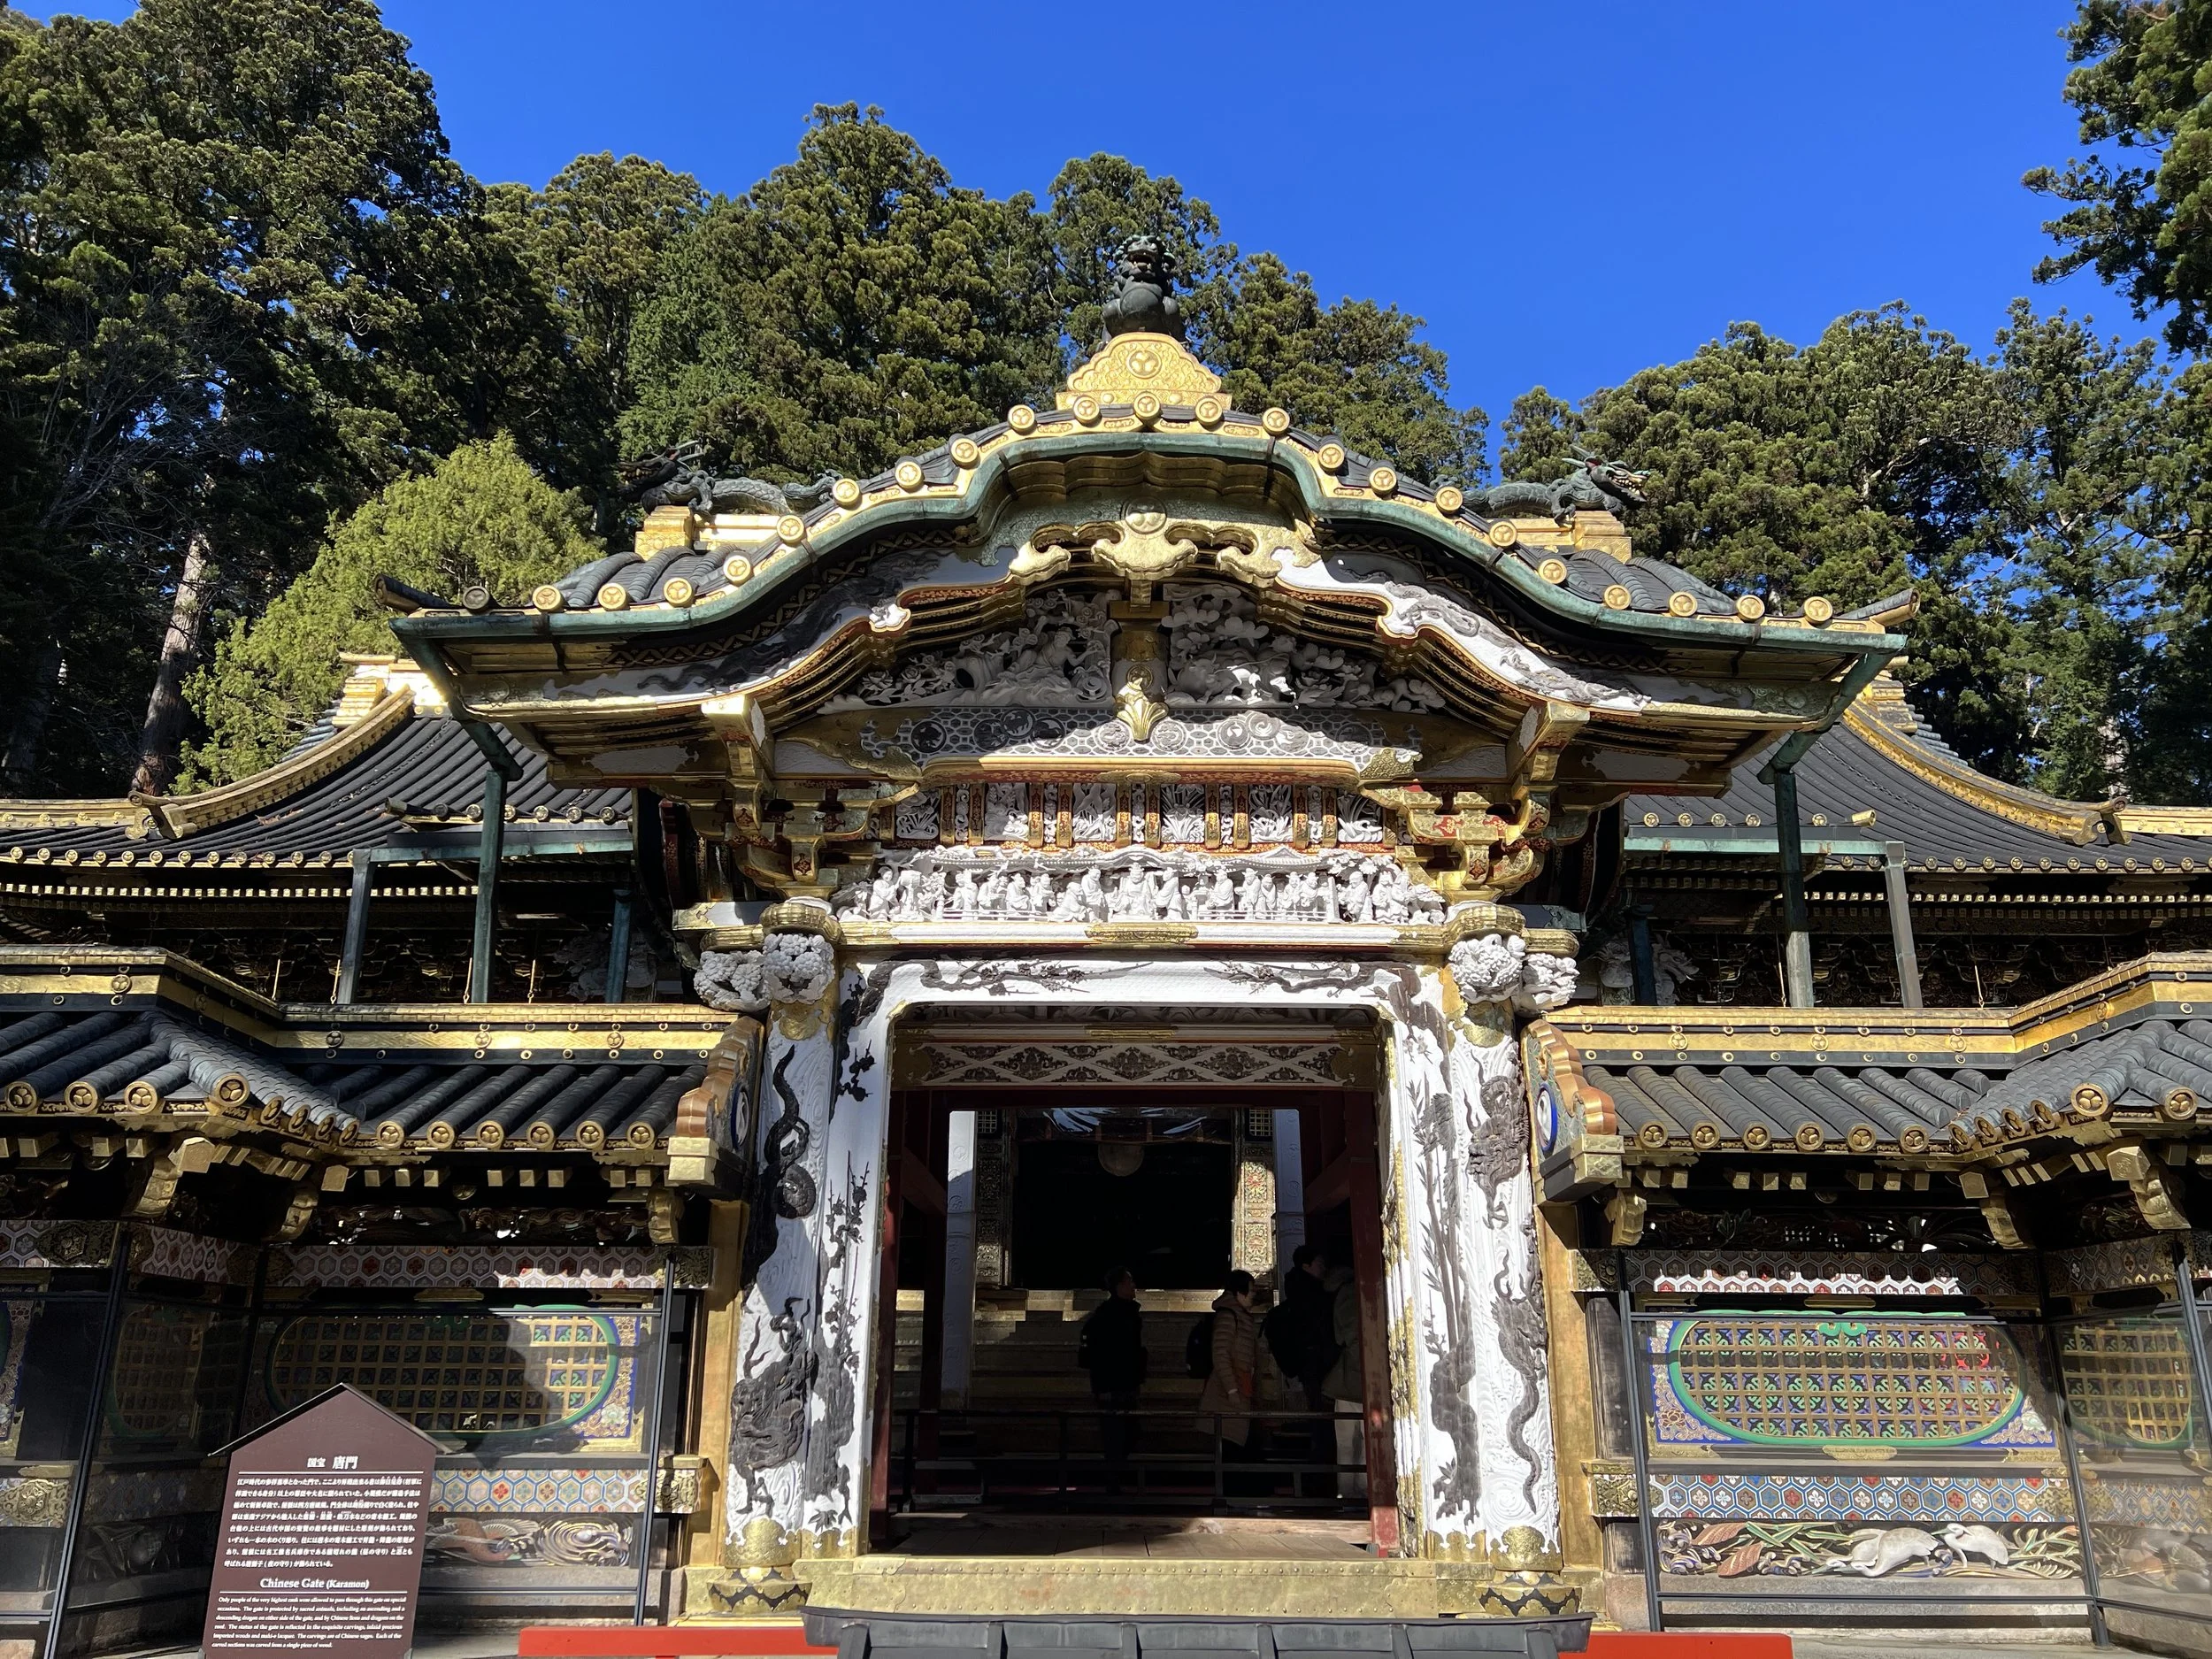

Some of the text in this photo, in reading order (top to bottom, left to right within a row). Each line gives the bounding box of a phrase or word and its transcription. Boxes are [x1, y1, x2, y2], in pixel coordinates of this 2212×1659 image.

[307, 1455, 359, 1470] 国宝 唐門
[260, 1578, 370, 1590] Chinese Gate (Karamon)
